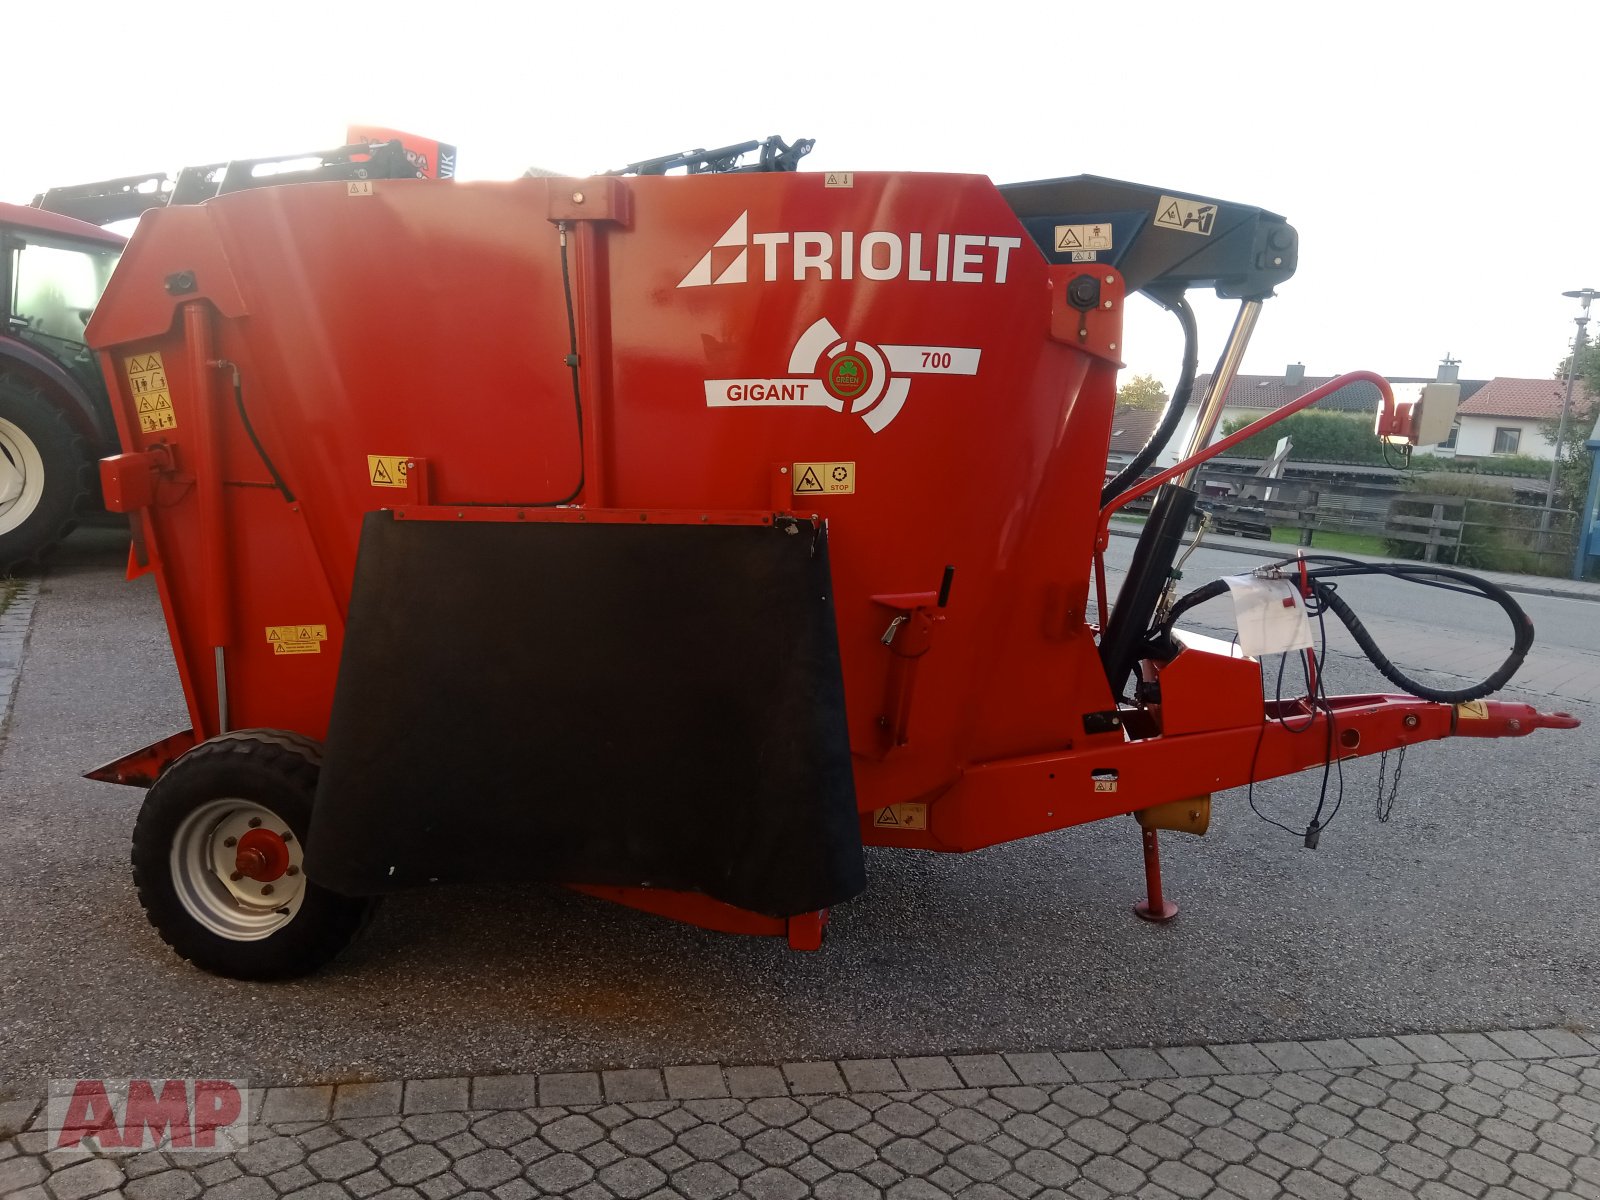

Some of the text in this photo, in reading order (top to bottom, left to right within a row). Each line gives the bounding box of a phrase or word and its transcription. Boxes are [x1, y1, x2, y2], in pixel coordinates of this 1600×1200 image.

[752, 231, 1022, 284] TRIOLIET
[921, 352, 952, 369] 700
[836, 376, 859, 384] GREEN
[726, 384, 809, 402] GIGANT
